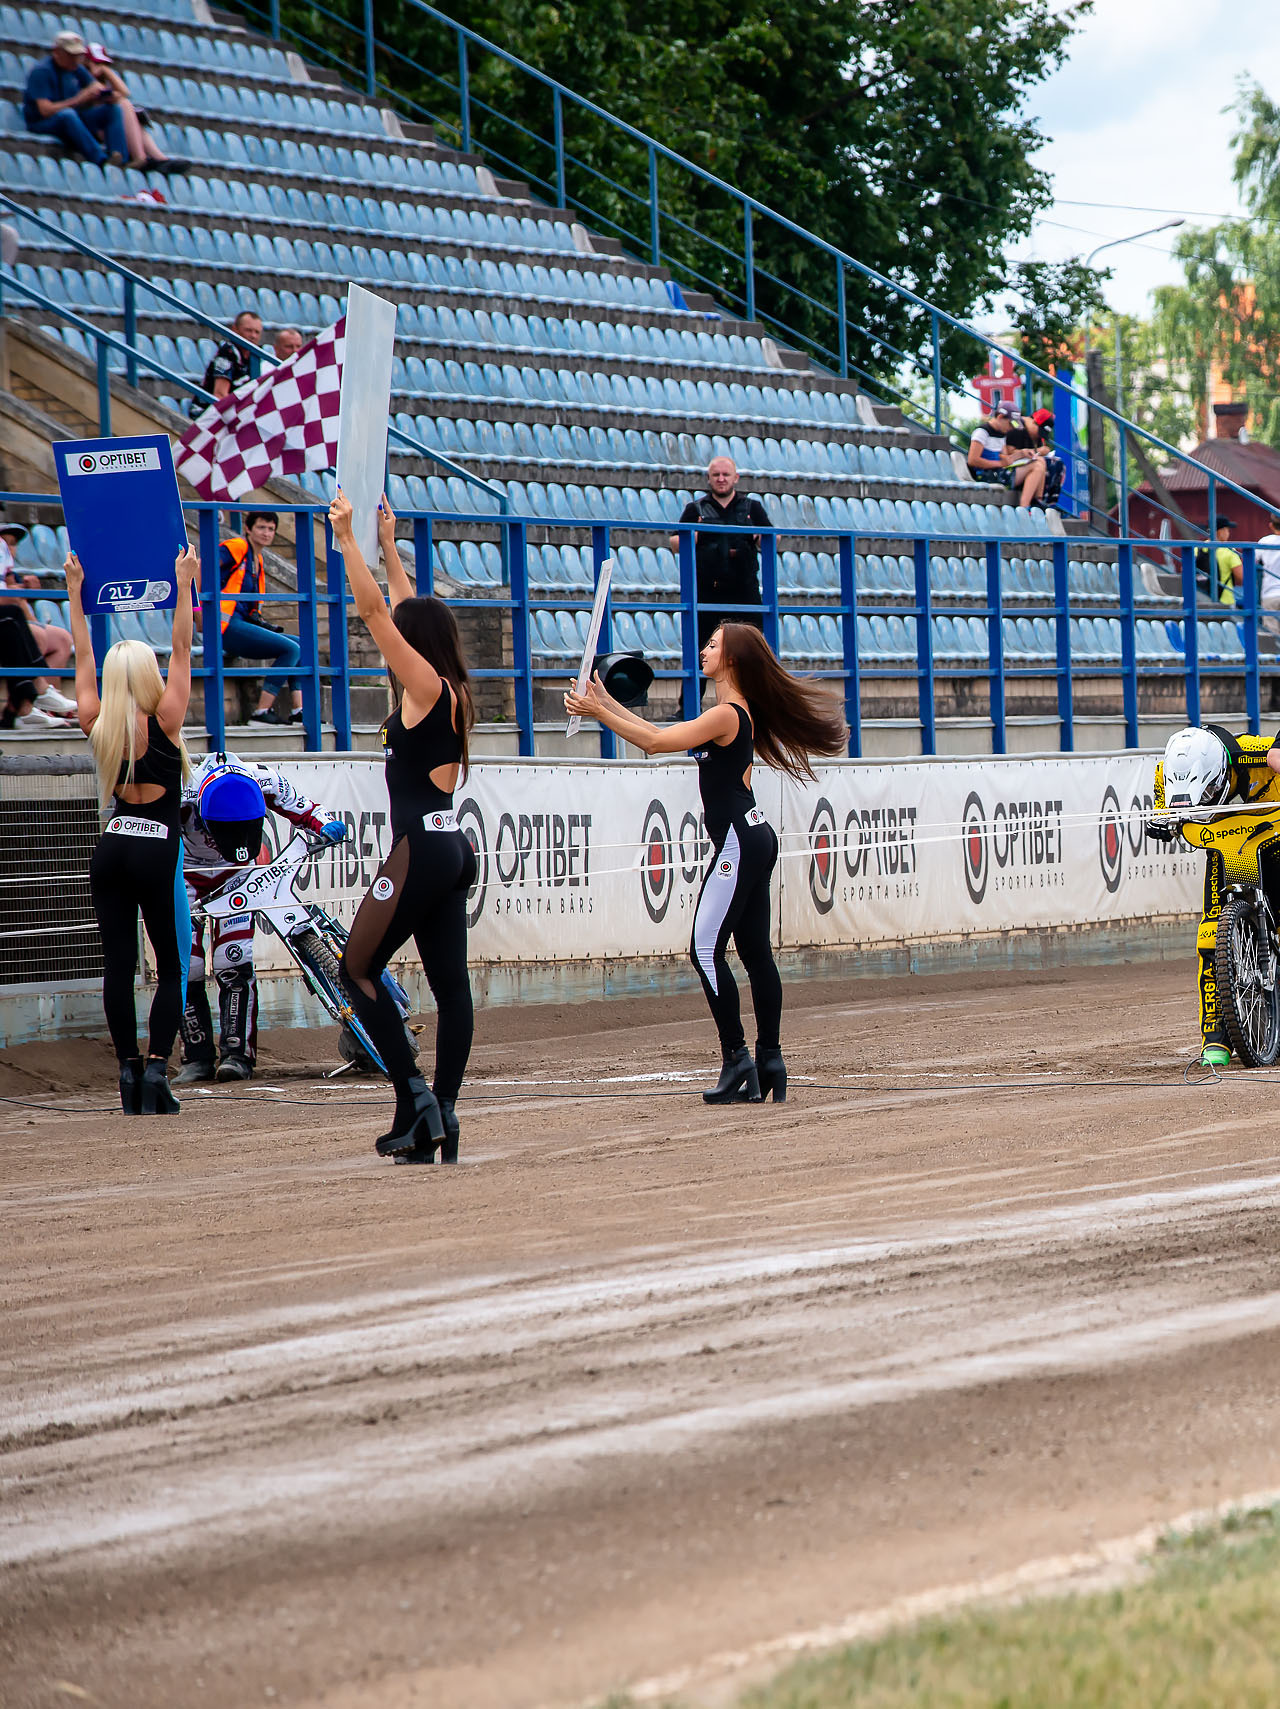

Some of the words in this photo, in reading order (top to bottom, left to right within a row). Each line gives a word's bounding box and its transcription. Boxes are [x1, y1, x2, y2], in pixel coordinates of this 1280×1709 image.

[100, 452, 147, 466] OPTIBET
[109, 583, 135, 600] 2LŽ
[124, 820, 162, 833] OPTIBET
[993, 800, 1063, 868] OPTIBET
[495, 812, 592, 888] OPTIBET
[844, 807, 917, 878] OPTIBET
[246, 857, 290, 893] OPTIBET
[995, 873, 1034, 892] SPORTA
[1040, 868, 1065, 887] BĀRS
[1128, 860, 1167, 880] SPORTA
[843, 885, 889, 902] SPORTA
[896, 878, 920, 899] BĀRS
[495, 898, 552, 915] SPORTA
[560, 892, 594, 914] BĀRS
[231, 992, 240, 1016] NORTH
